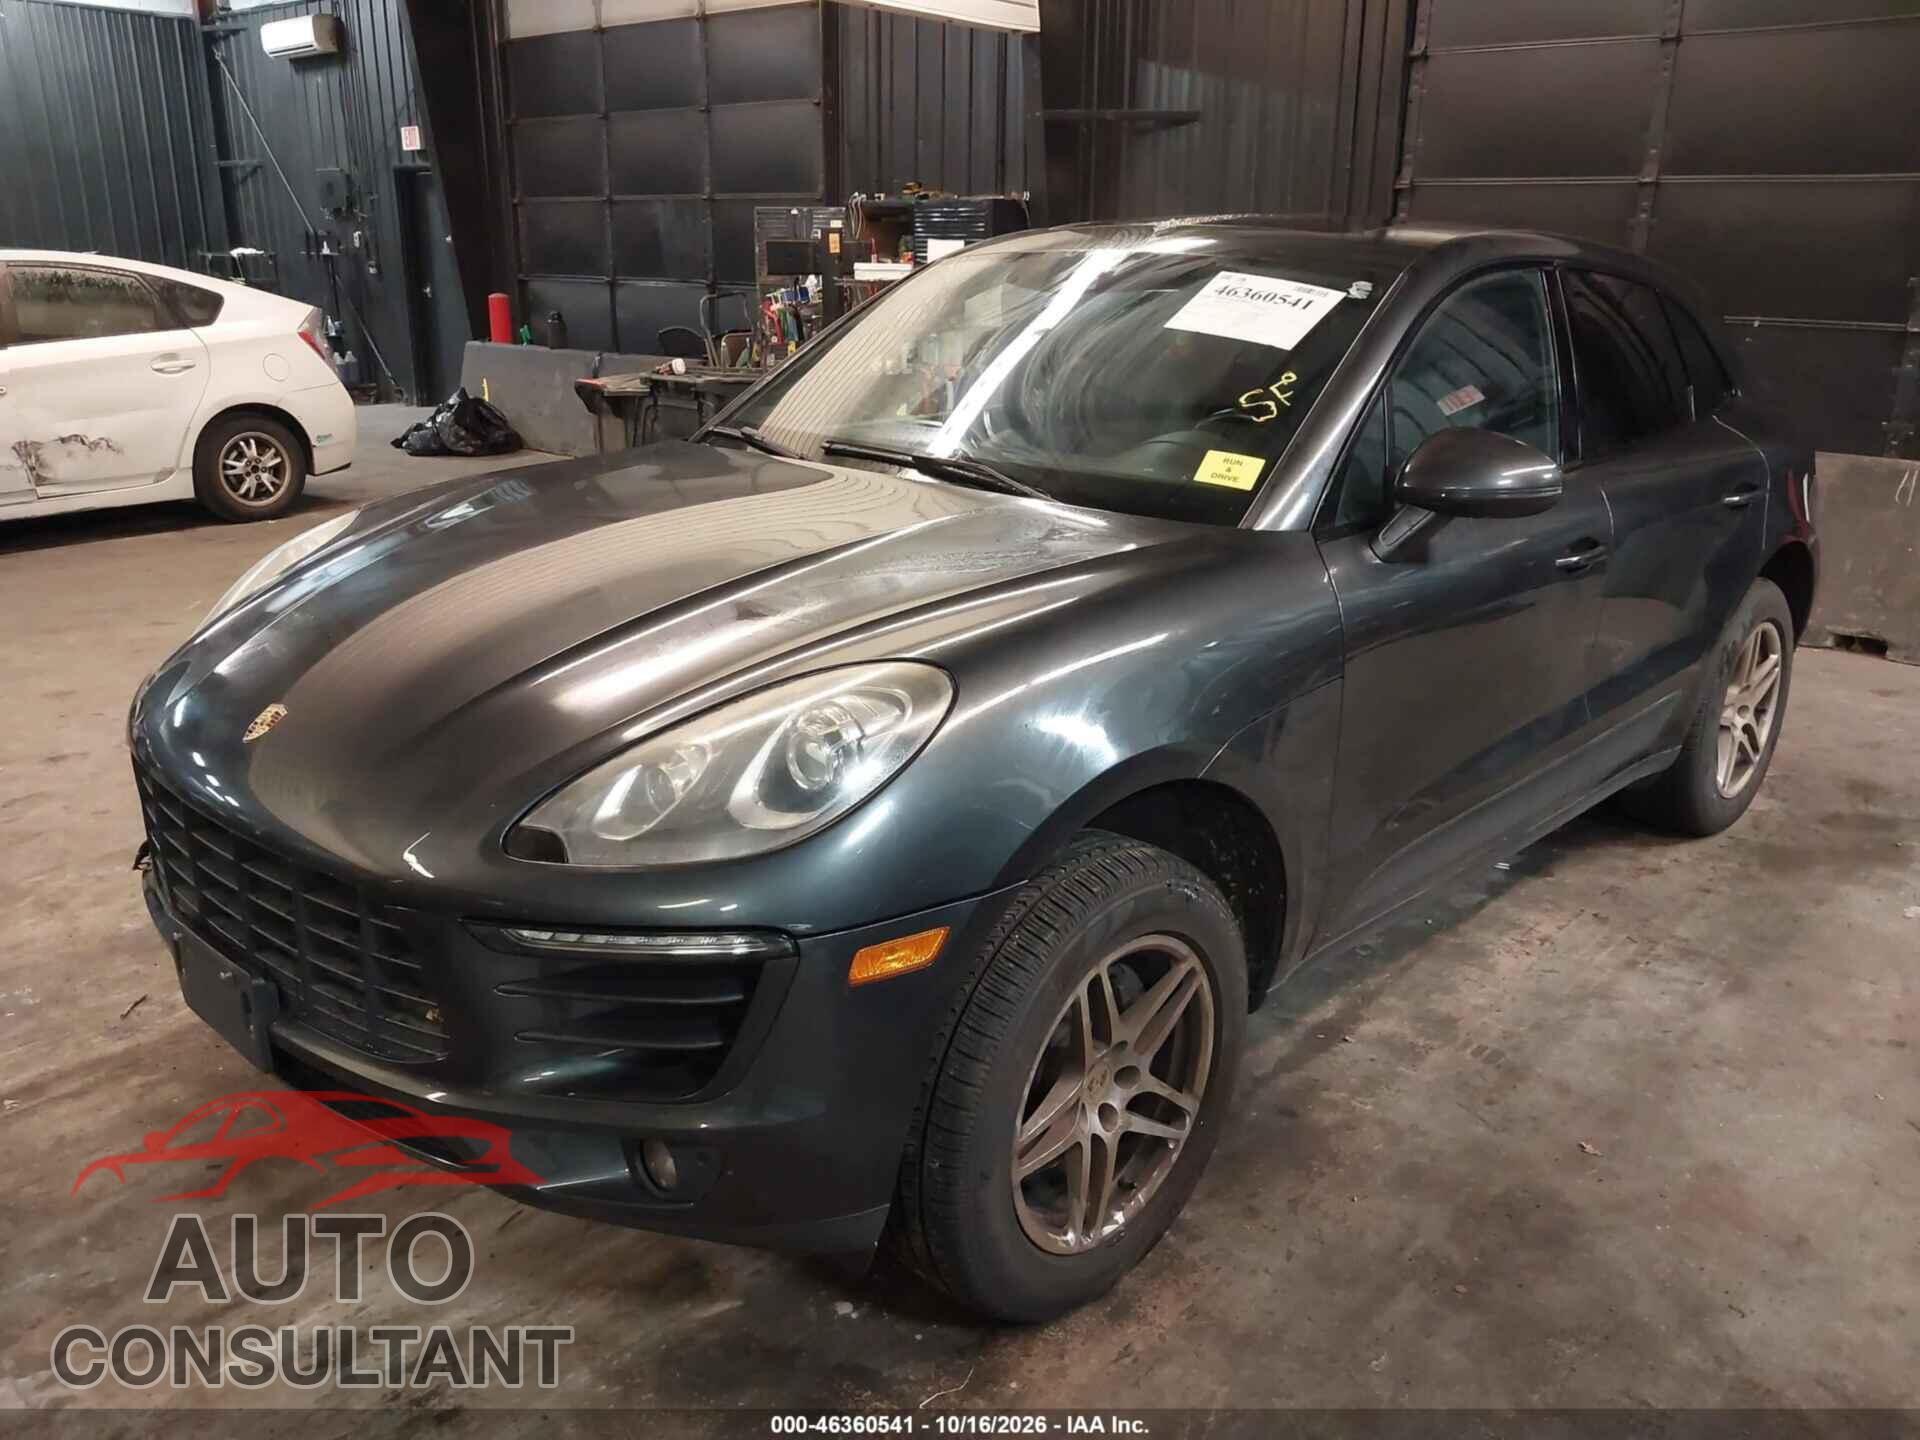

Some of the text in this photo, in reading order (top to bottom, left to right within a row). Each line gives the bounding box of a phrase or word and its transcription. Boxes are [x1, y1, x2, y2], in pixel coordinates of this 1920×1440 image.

[1214, 285, 1314, 310] 46360541
[1222, 457, 1243, 466] RUN
[1210, 472, 1240, 482] DRIVE
